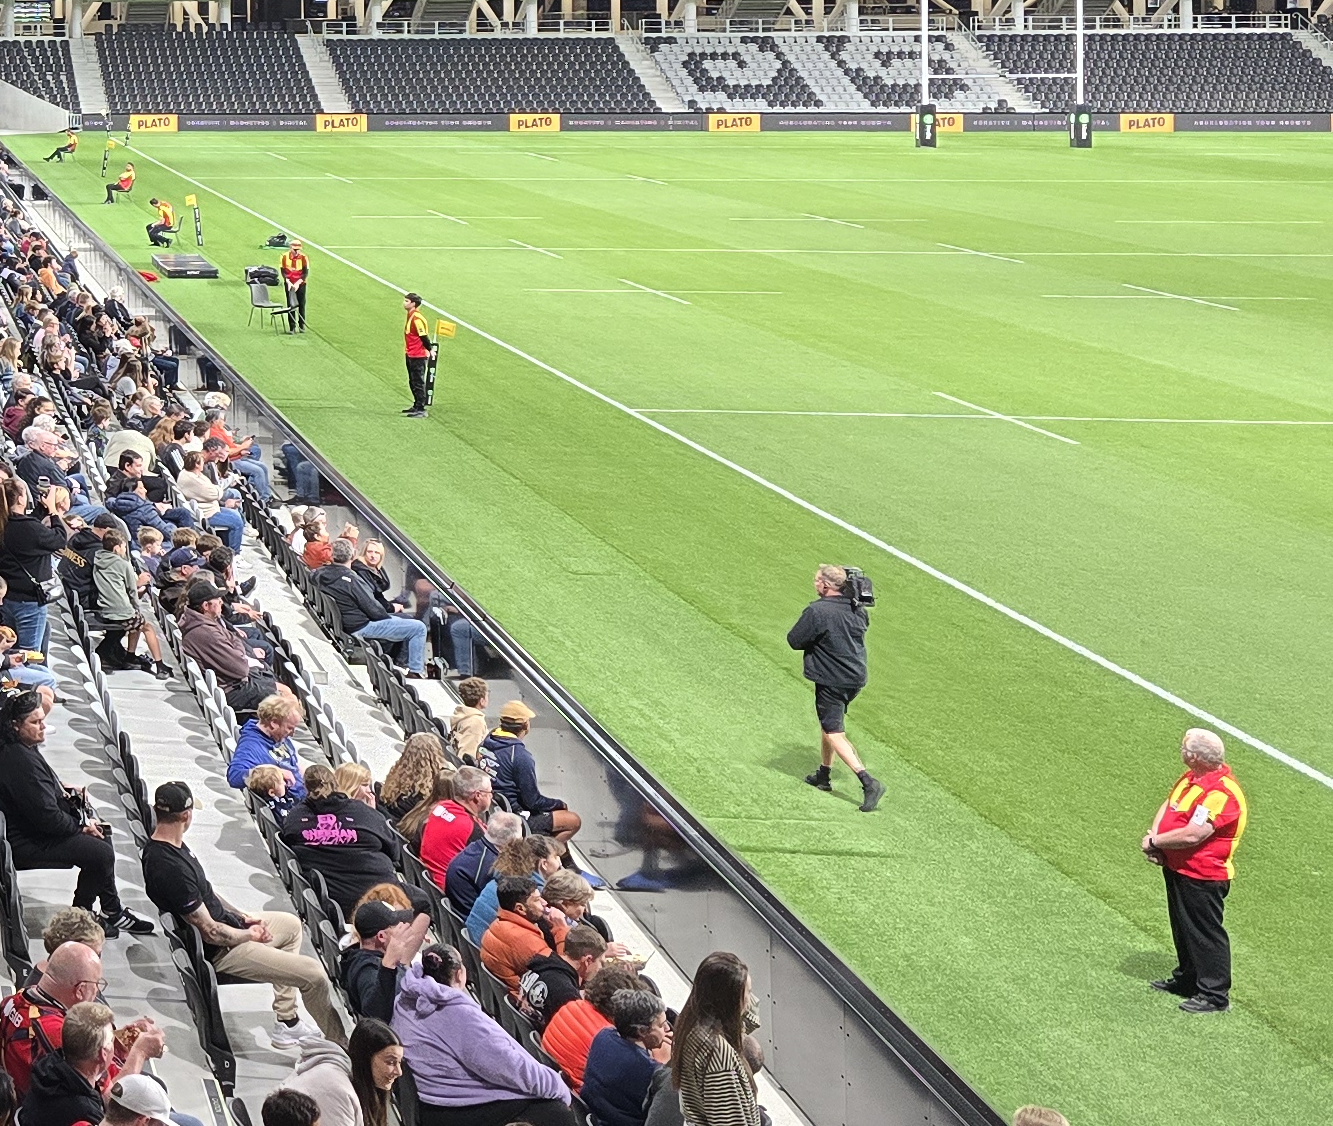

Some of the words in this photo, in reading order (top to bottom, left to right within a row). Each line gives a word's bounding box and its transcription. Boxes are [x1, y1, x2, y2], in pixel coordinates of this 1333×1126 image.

[137, 116, 171, 130] PLATO
[323, 116, 359, 130] PLATO
[517, 116, 553, 130] PLATO
[716, 116, 753, 130] PLATO
[935, 116, 955, 128] ATO
[1128, 116, 1166, 130] PLATO
[22, 968, 29, 977] E
